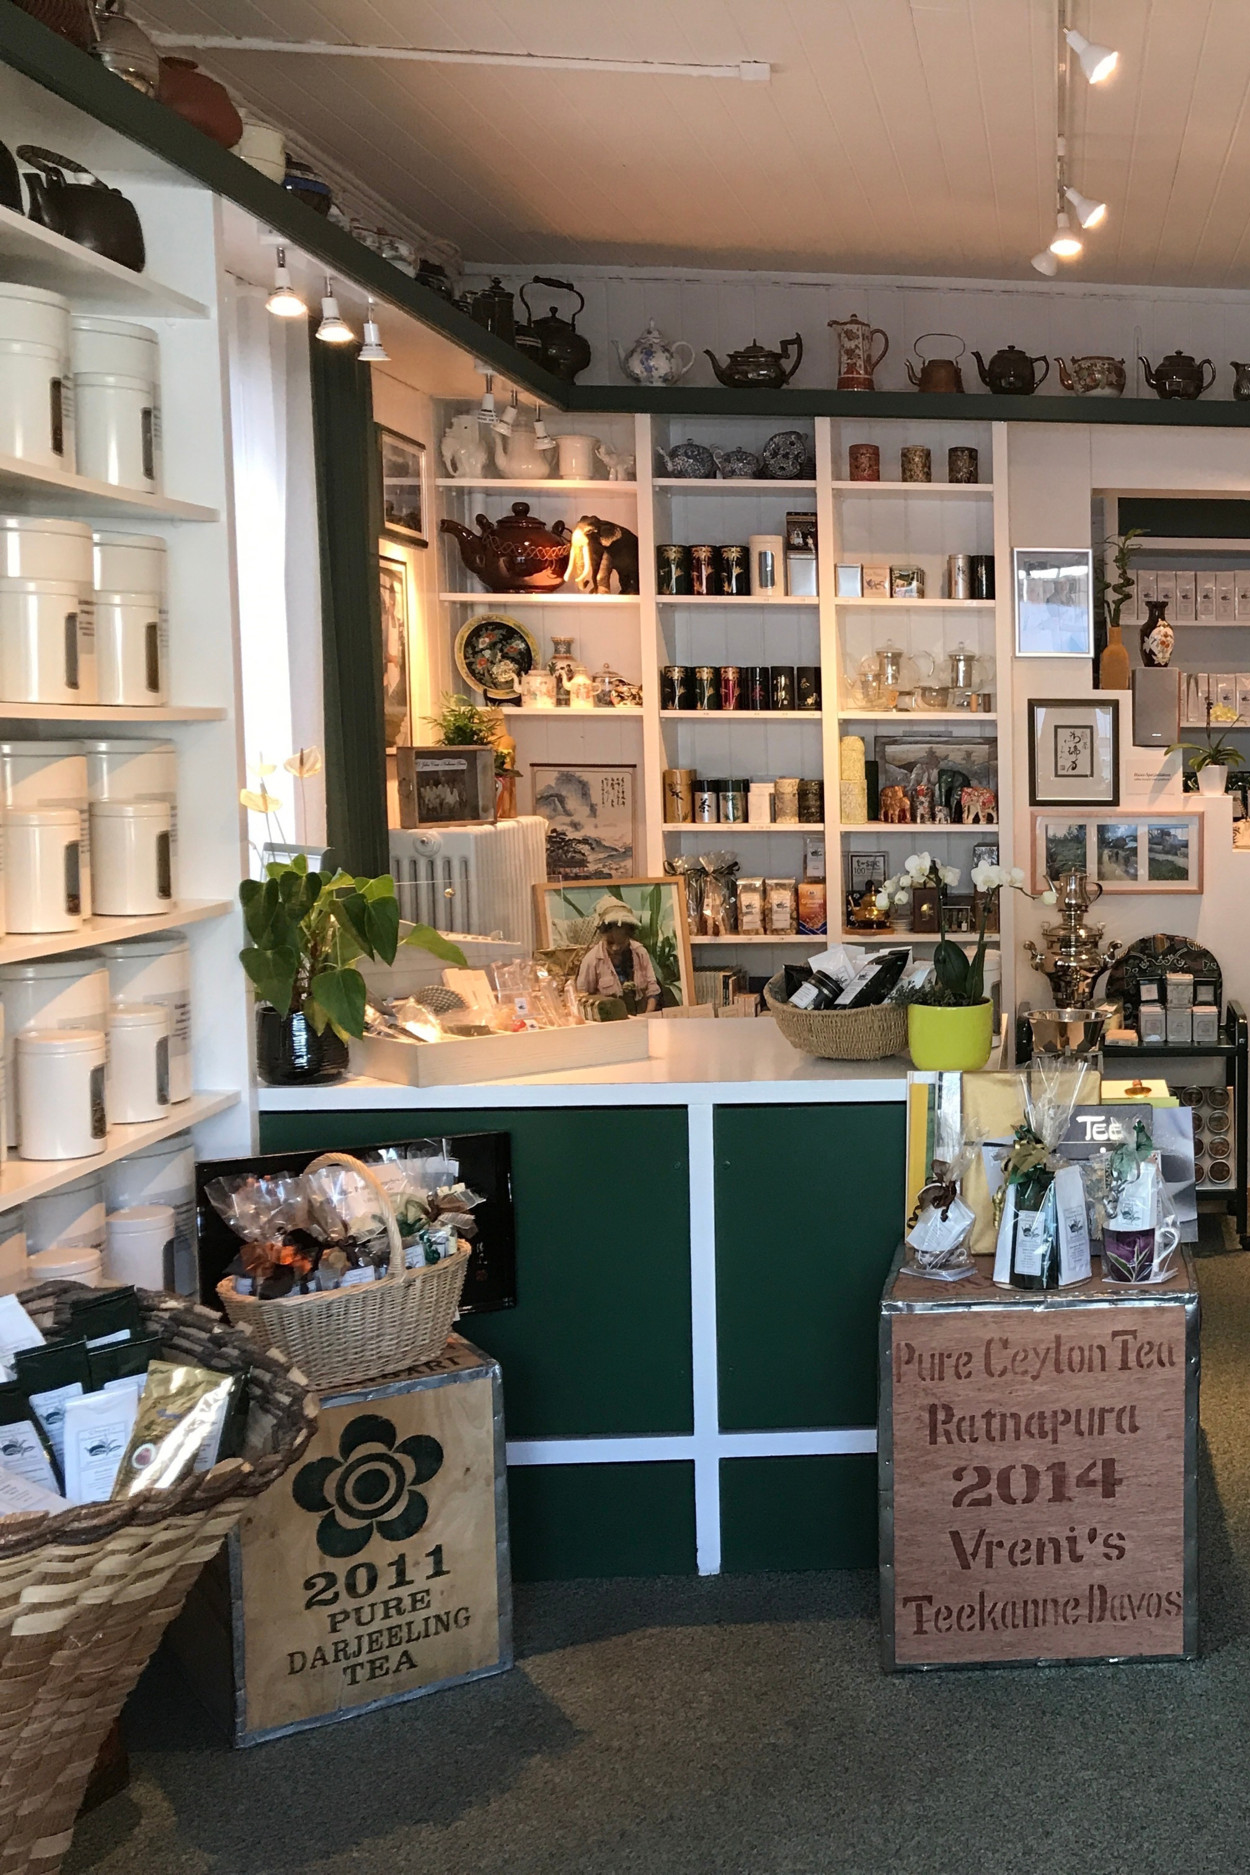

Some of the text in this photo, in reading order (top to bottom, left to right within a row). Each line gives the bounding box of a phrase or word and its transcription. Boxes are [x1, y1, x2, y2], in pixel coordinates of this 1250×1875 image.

[893, 1329, 1176, 1383] Pure Ceylon Tea
[928, 1402, 1140, 1445] Ratnapura
[952, 1457, 1123, 1508] 2014
[949, 1526, 1127, 1570] Vreni's
[303, 1543, 451, 1611] 2011
[327, 1588, 431, 1634] PURE
[902, 1583, 1183, 1636] Teekanne Davos
[286, 1607, 472, 1675] DARJEELING
[342, 1650, 419, 1686] TEA
